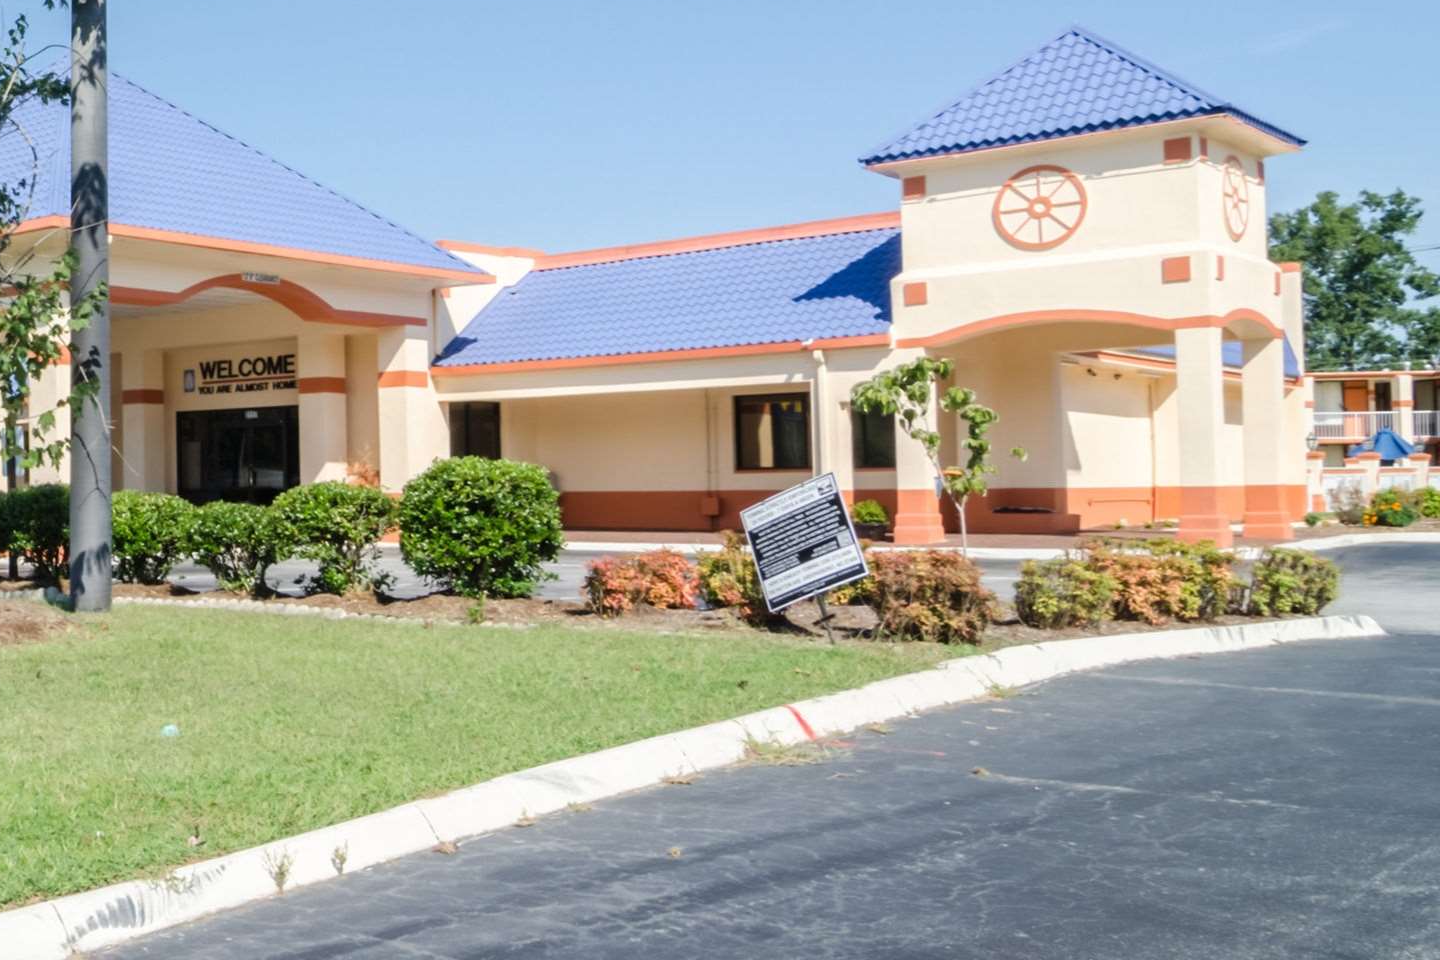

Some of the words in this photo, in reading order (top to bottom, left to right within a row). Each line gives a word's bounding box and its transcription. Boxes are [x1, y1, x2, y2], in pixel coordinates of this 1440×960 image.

[199, 354, 296, 379] WELCOME
[198, 386, 215, 395] YOU
[216, 384, 233, 394] ARE
[235, 382, 269, 393] ALMOST
[272, 380, 297, 390] HOME
